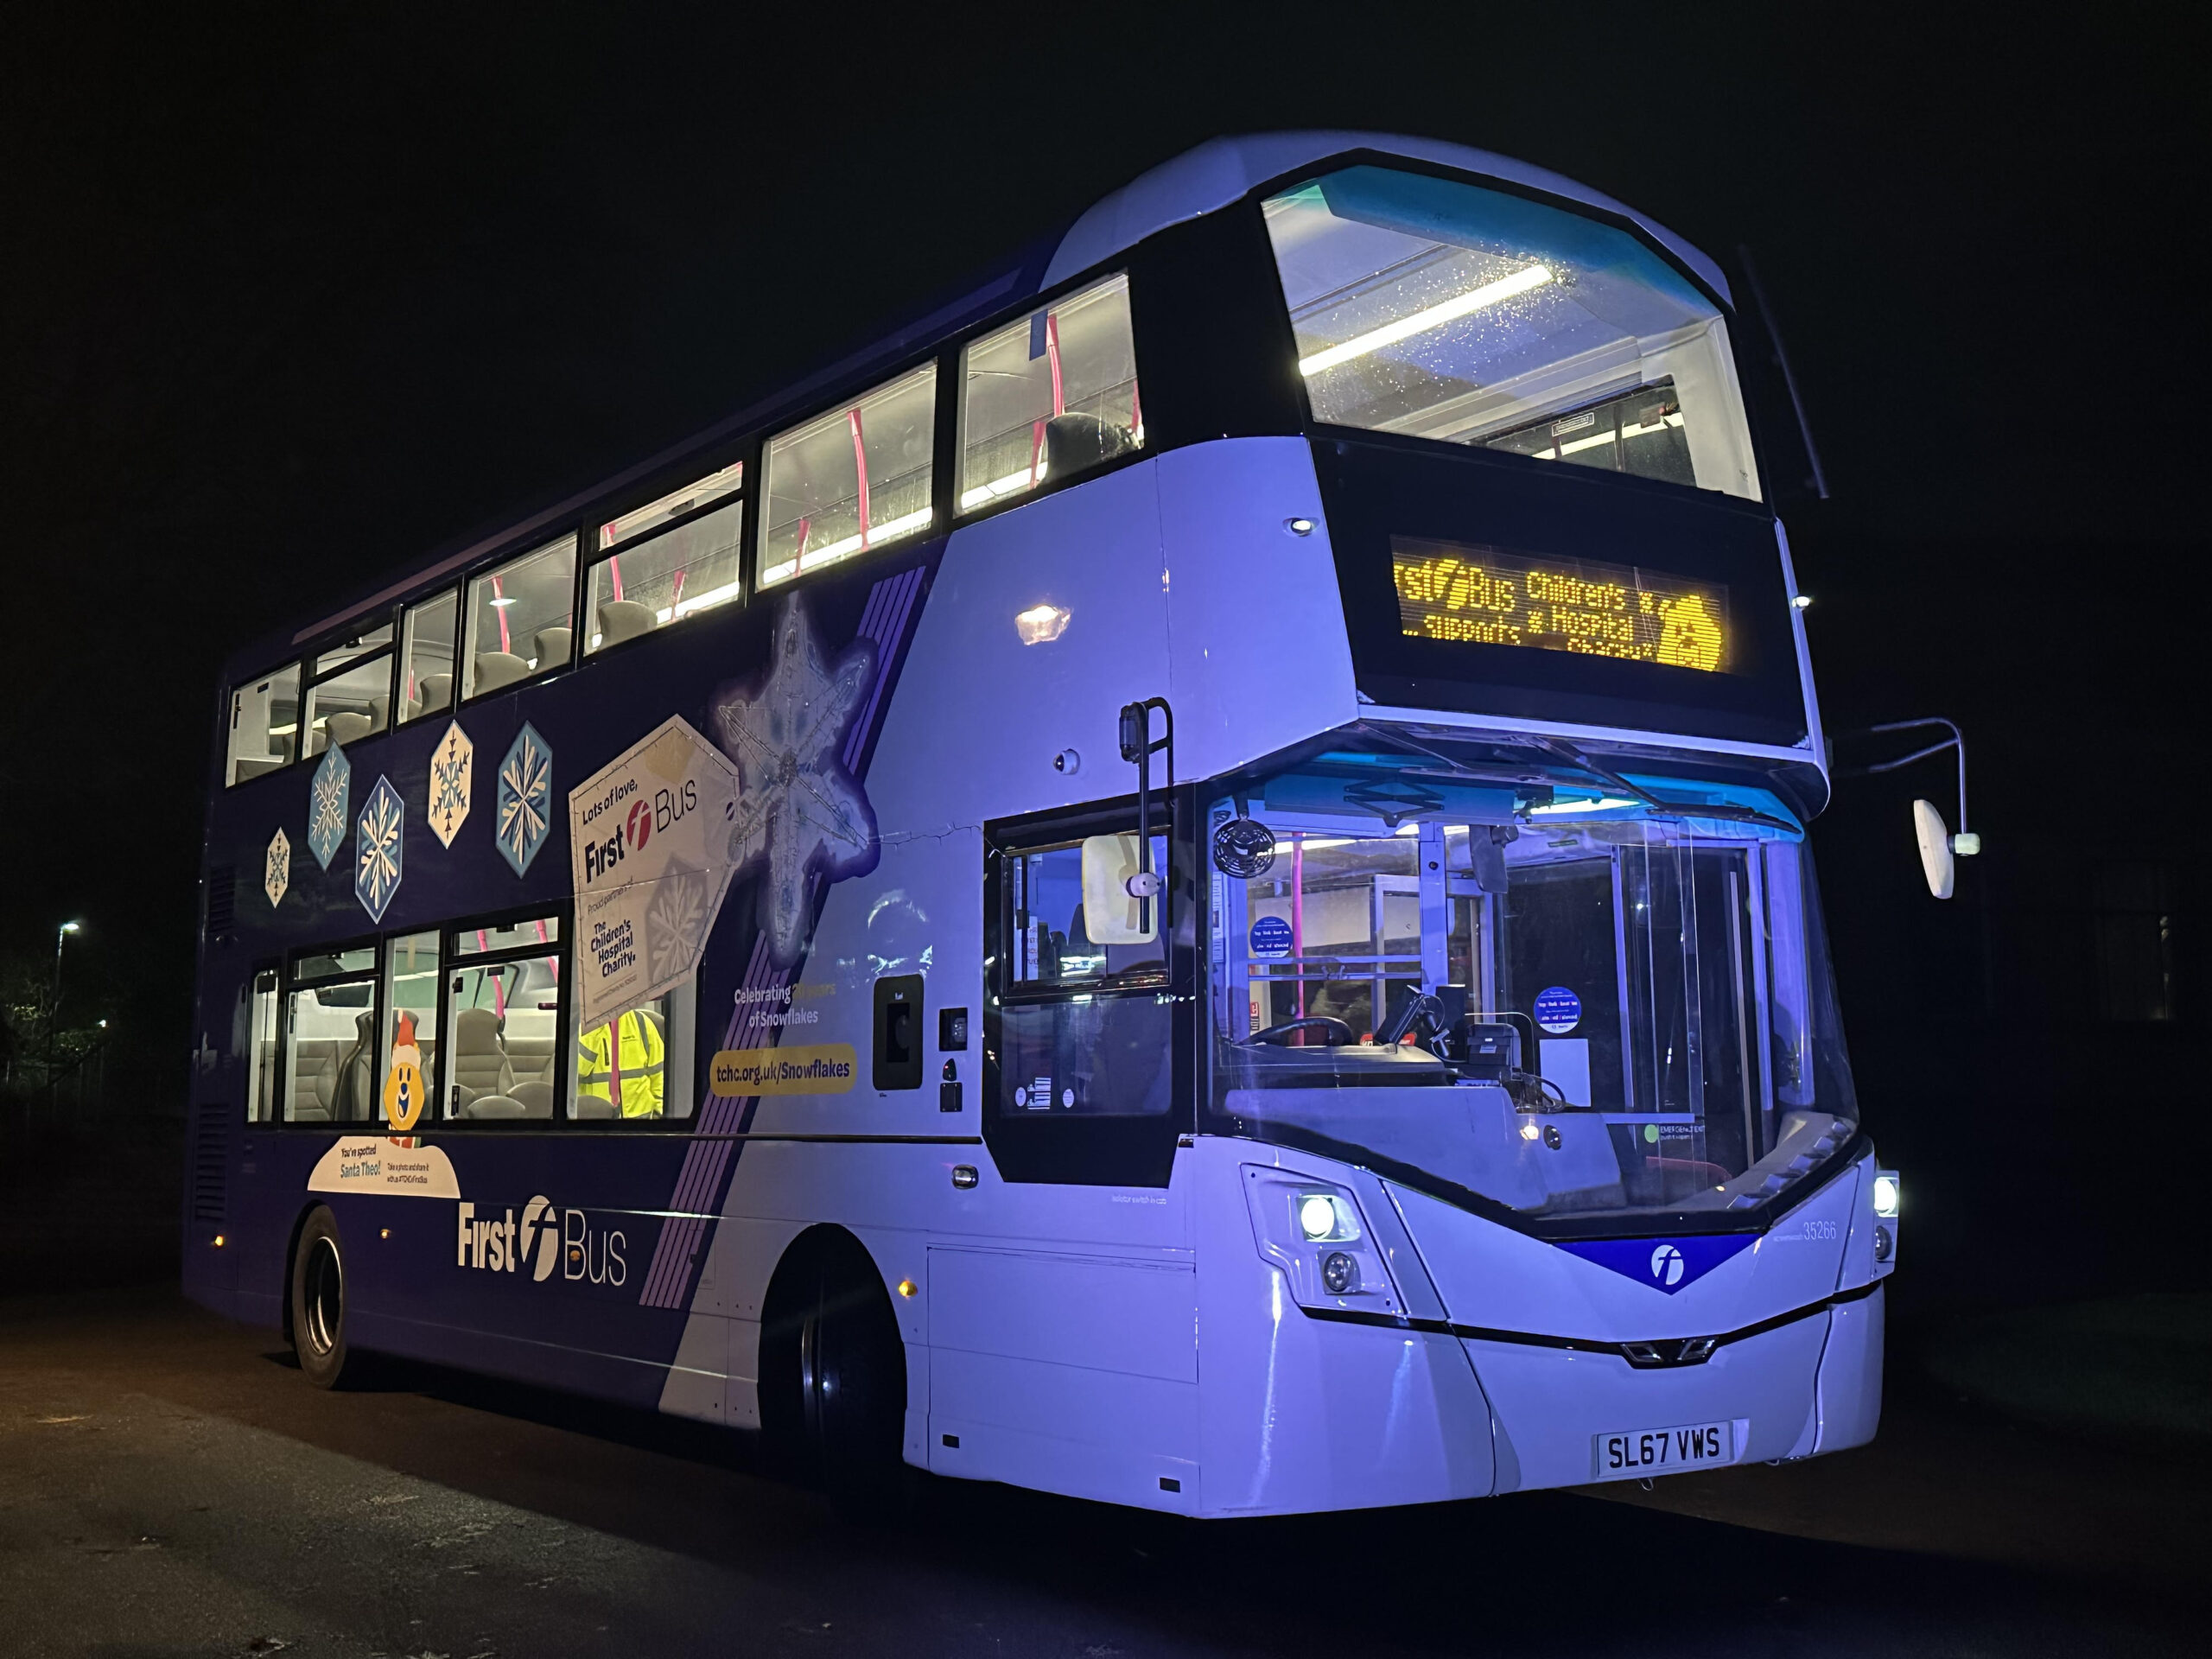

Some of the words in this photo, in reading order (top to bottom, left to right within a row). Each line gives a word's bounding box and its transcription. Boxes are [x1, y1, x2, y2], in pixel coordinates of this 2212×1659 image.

[1470, 567, 1516, 613] Bus
[1527, 571, 1626, 610] Children's
[1552, 605, 1633, 641] Hospital
[582, 802, 603, 825] Lots
[604, 788, 614, 810] of
[614, 779, 638, 803] love,
[584, 823, 625, 883] First
[655, 779, 697, 833] Bus
[590, 919, 631, 952] Children's
[594, 921, 607, 935] The
[598, 931, 633, 964] Hospital
[734, 983, 791, 1004] Celebrating
[749, 1010, 760, 1028] of
[760, 1007, 819, 1027] Snowflakes
[716, 1058, 850, 1085] tchc.org.uk/Snowflakes
[357, 1143, 377, 1159] spotted
[340, 1162, 360, 1179] Santa
[361, 1160, 381, 1176] Theo!
[458, 1202, 515, 1273] First
[564, 1209, 626, 1287] Bus
[1803, 1221, 1836, 1241] 35266
[1608, 1432, 1669, 1469] SL67
[1676, 1427, 1719, 1461] VWS
